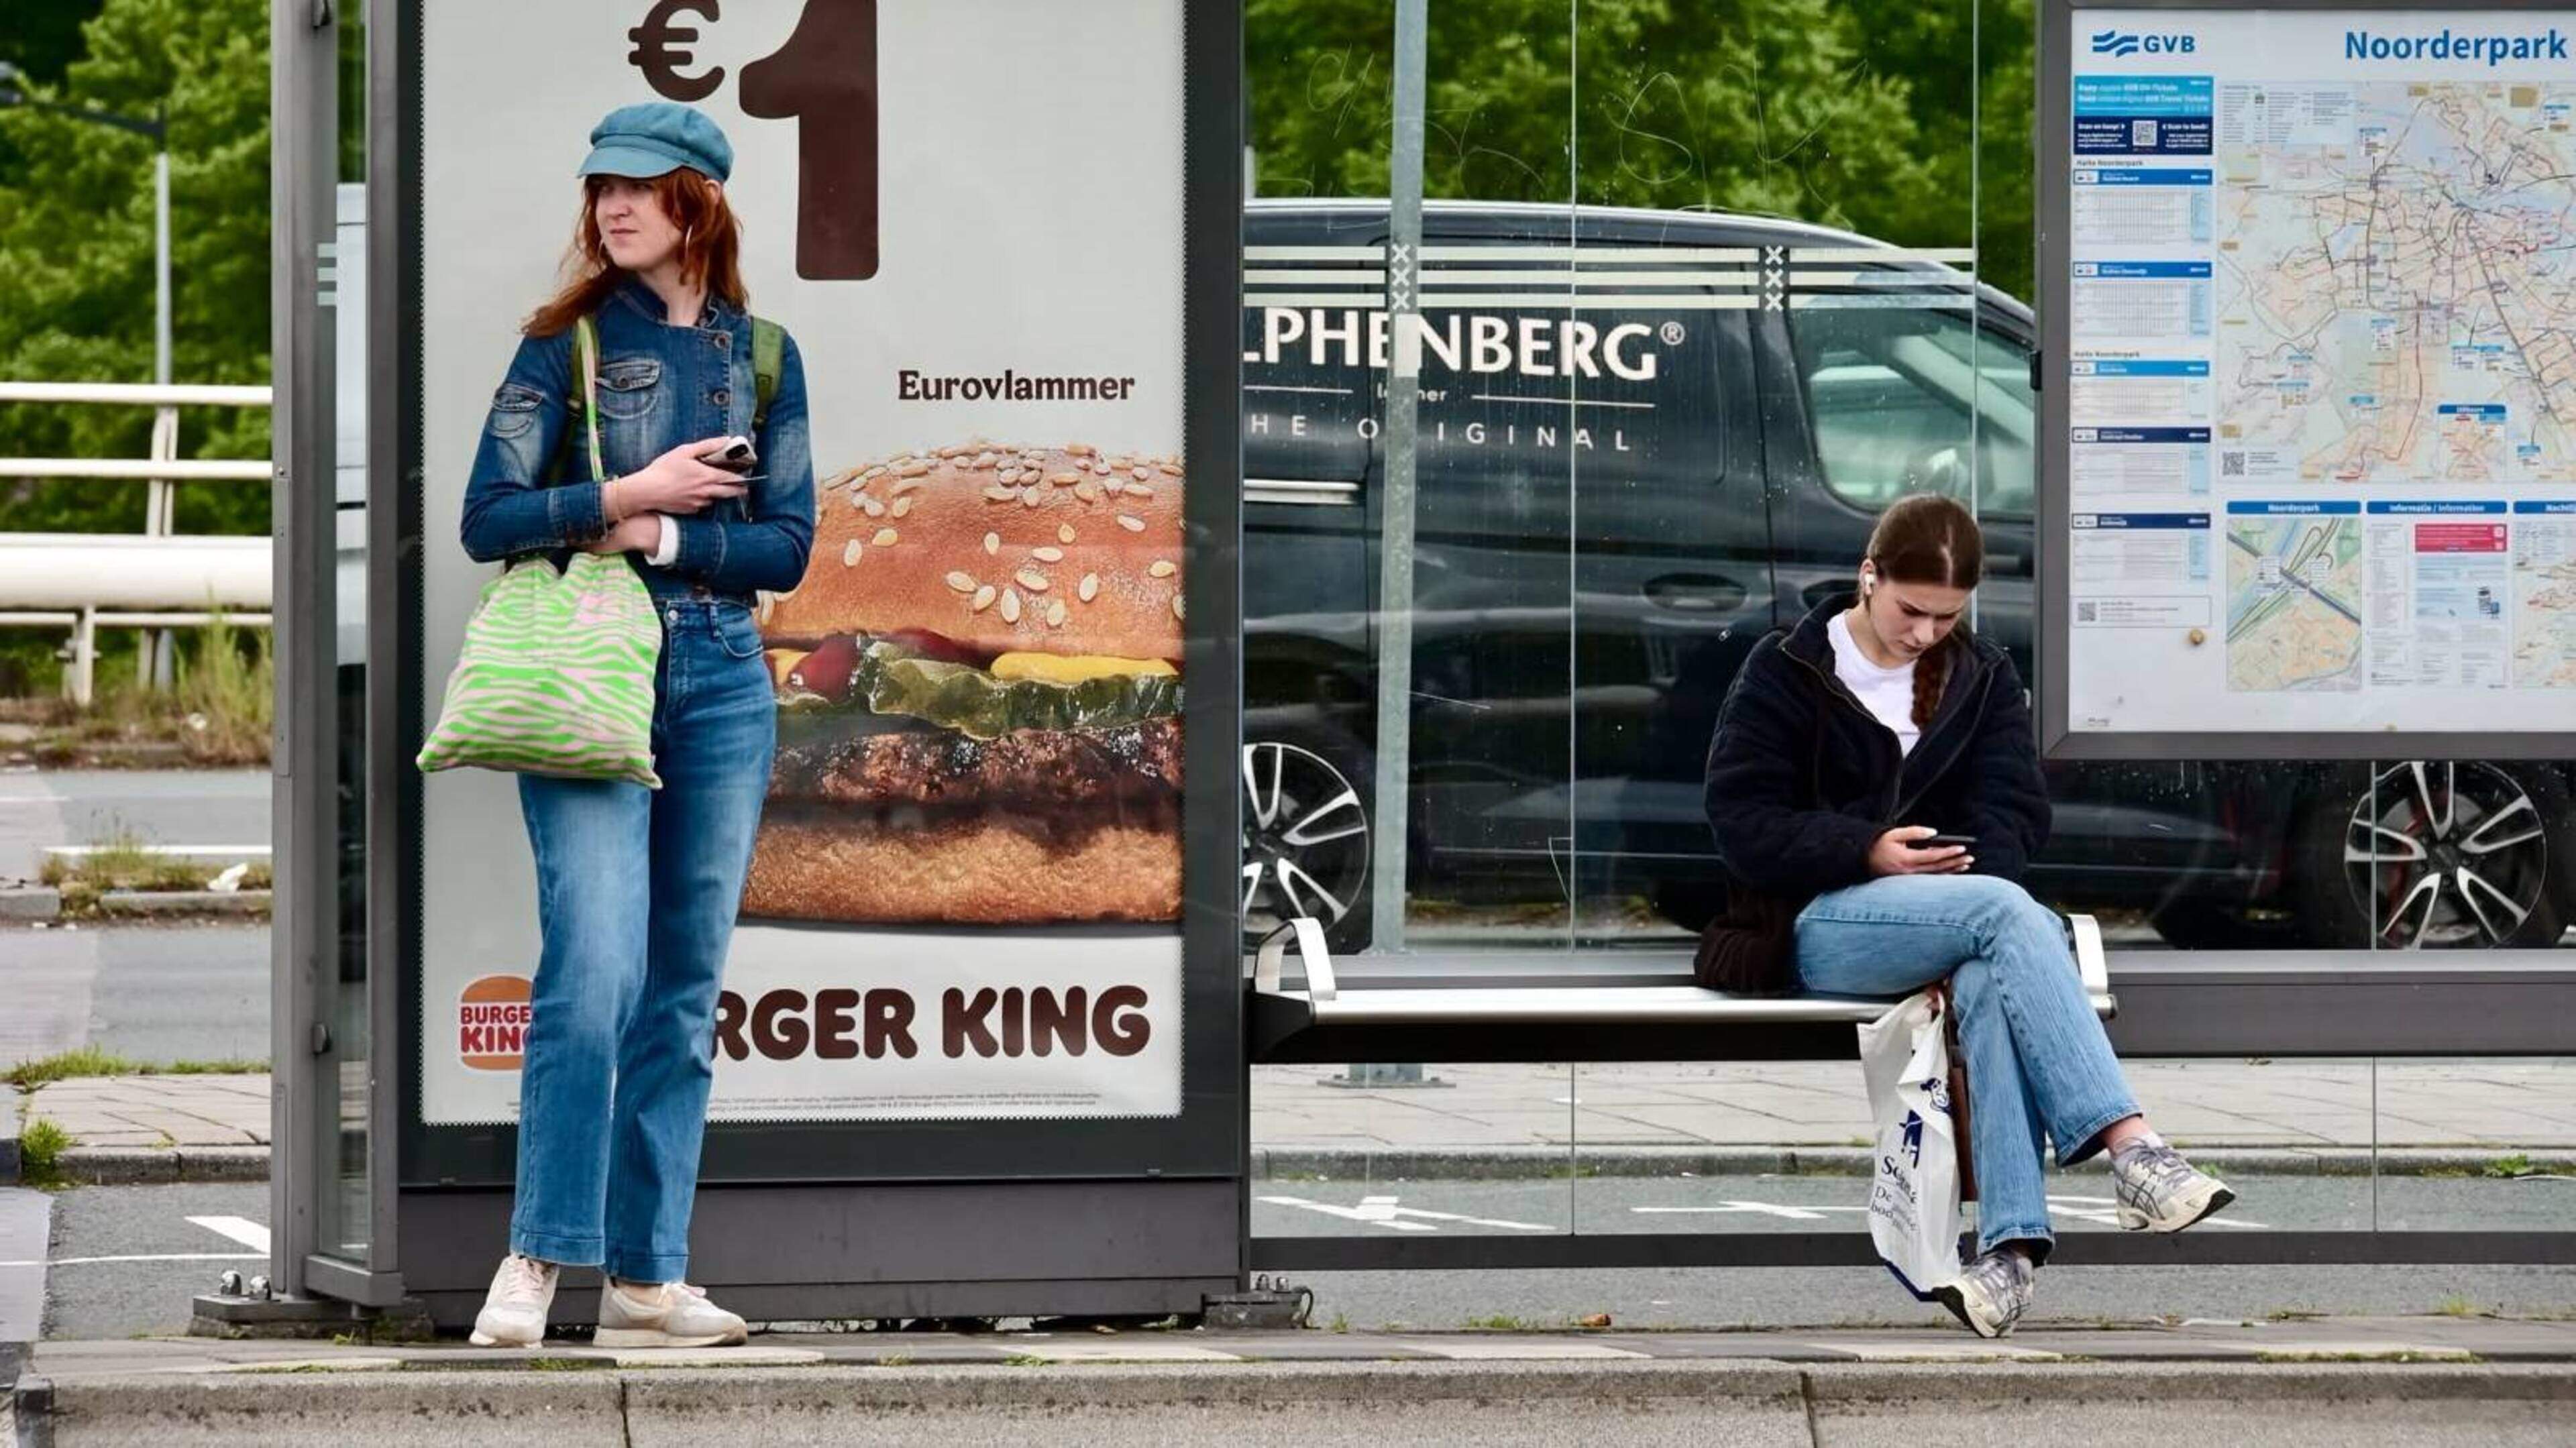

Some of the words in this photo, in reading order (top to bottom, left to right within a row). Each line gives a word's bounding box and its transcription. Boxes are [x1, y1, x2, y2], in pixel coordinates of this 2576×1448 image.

[2143, 35, 2195, 53] GVB
[2345, 30, 2567, 66] Noorderpark
[898, 370, 1135, 400] Eurovlammer
[1357, 417, 1631, 451] OIGINAL
[460, 1006, 532, 1024] BURGE
[711, 989, 918, 1061] RGER
[943, 985, 1150, 1058] KING
